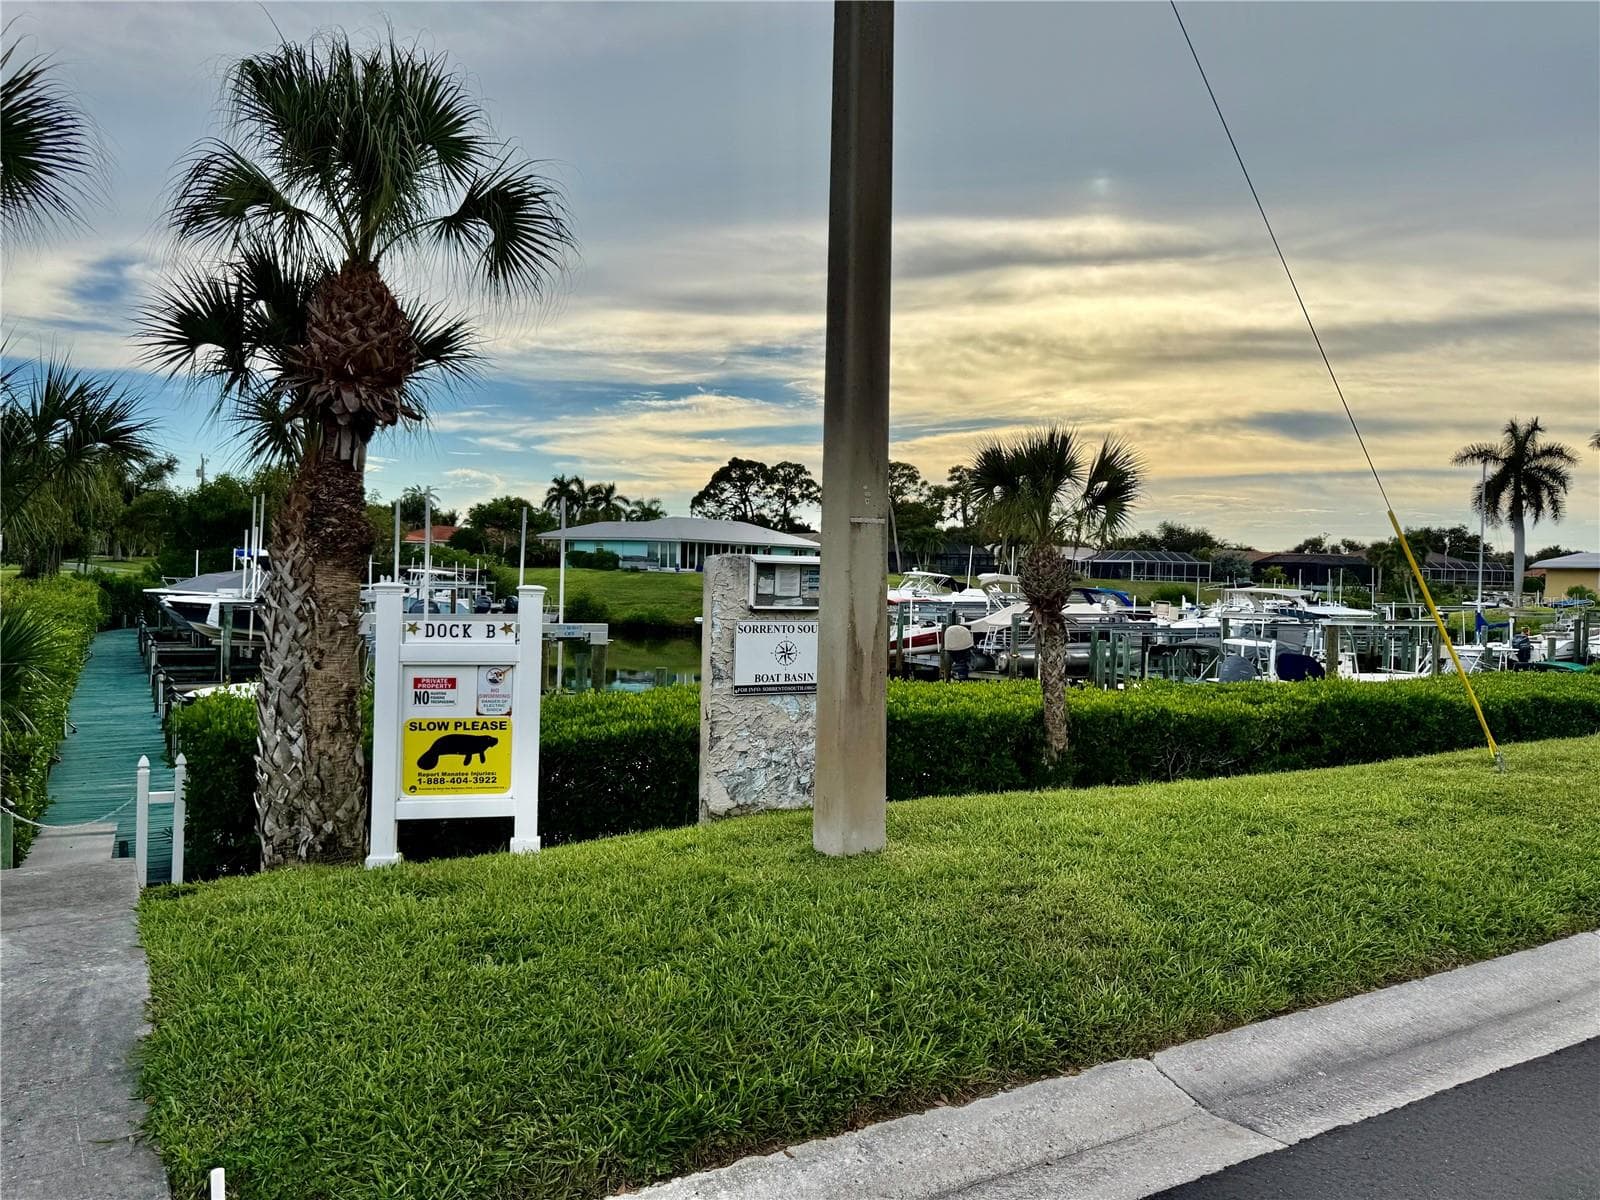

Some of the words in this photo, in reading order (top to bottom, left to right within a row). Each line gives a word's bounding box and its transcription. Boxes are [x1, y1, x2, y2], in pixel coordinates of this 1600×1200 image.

[425, 623, 472, 638] DOCK
[486, 624, 496, 639] B
[737, 624, 795, 634] SORRENTO
[754, 673, 782, 683] BOAT
[784, 672, 814, 682] BASIN
[414, 690, 430, 705] NO
[409, 721, 449, 731] SLOW
[454, 721, 507, 731] PLEASE
[417, 777, 497, 785] 1-888-404-3922
